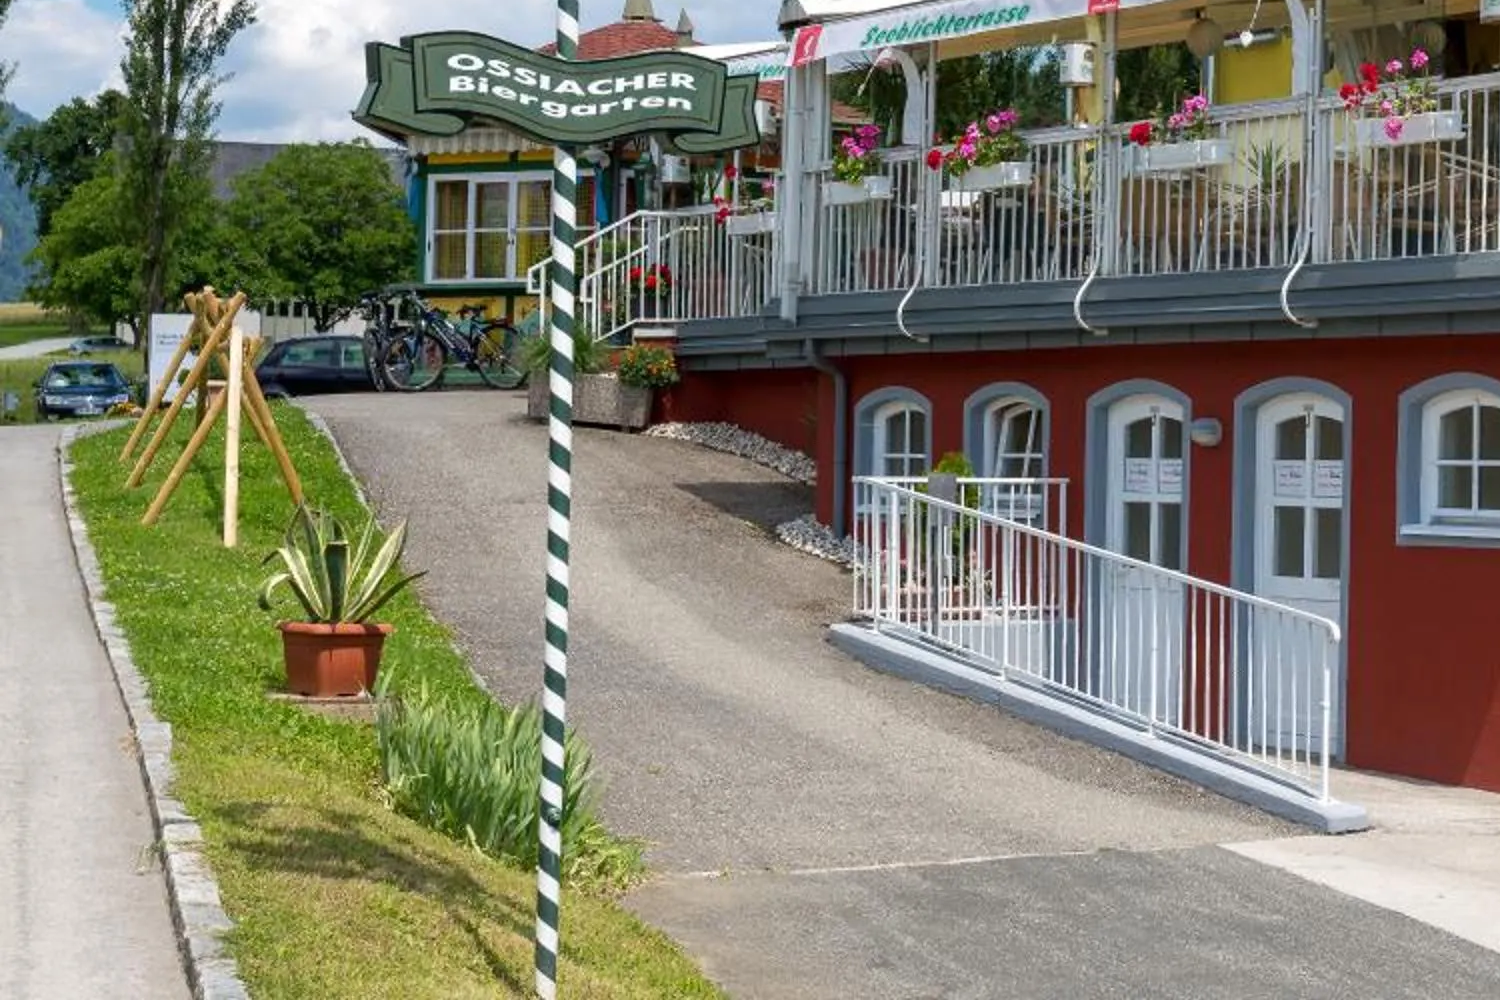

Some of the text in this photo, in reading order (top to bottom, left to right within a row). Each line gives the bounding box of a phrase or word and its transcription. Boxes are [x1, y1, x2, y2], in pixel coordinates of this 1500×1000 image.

[860, 5, 1030, 47] Seeblickterrasse
[447, 53, 697, 96] OSSIACHER
[449, 75, 693, 119] Biergarten
